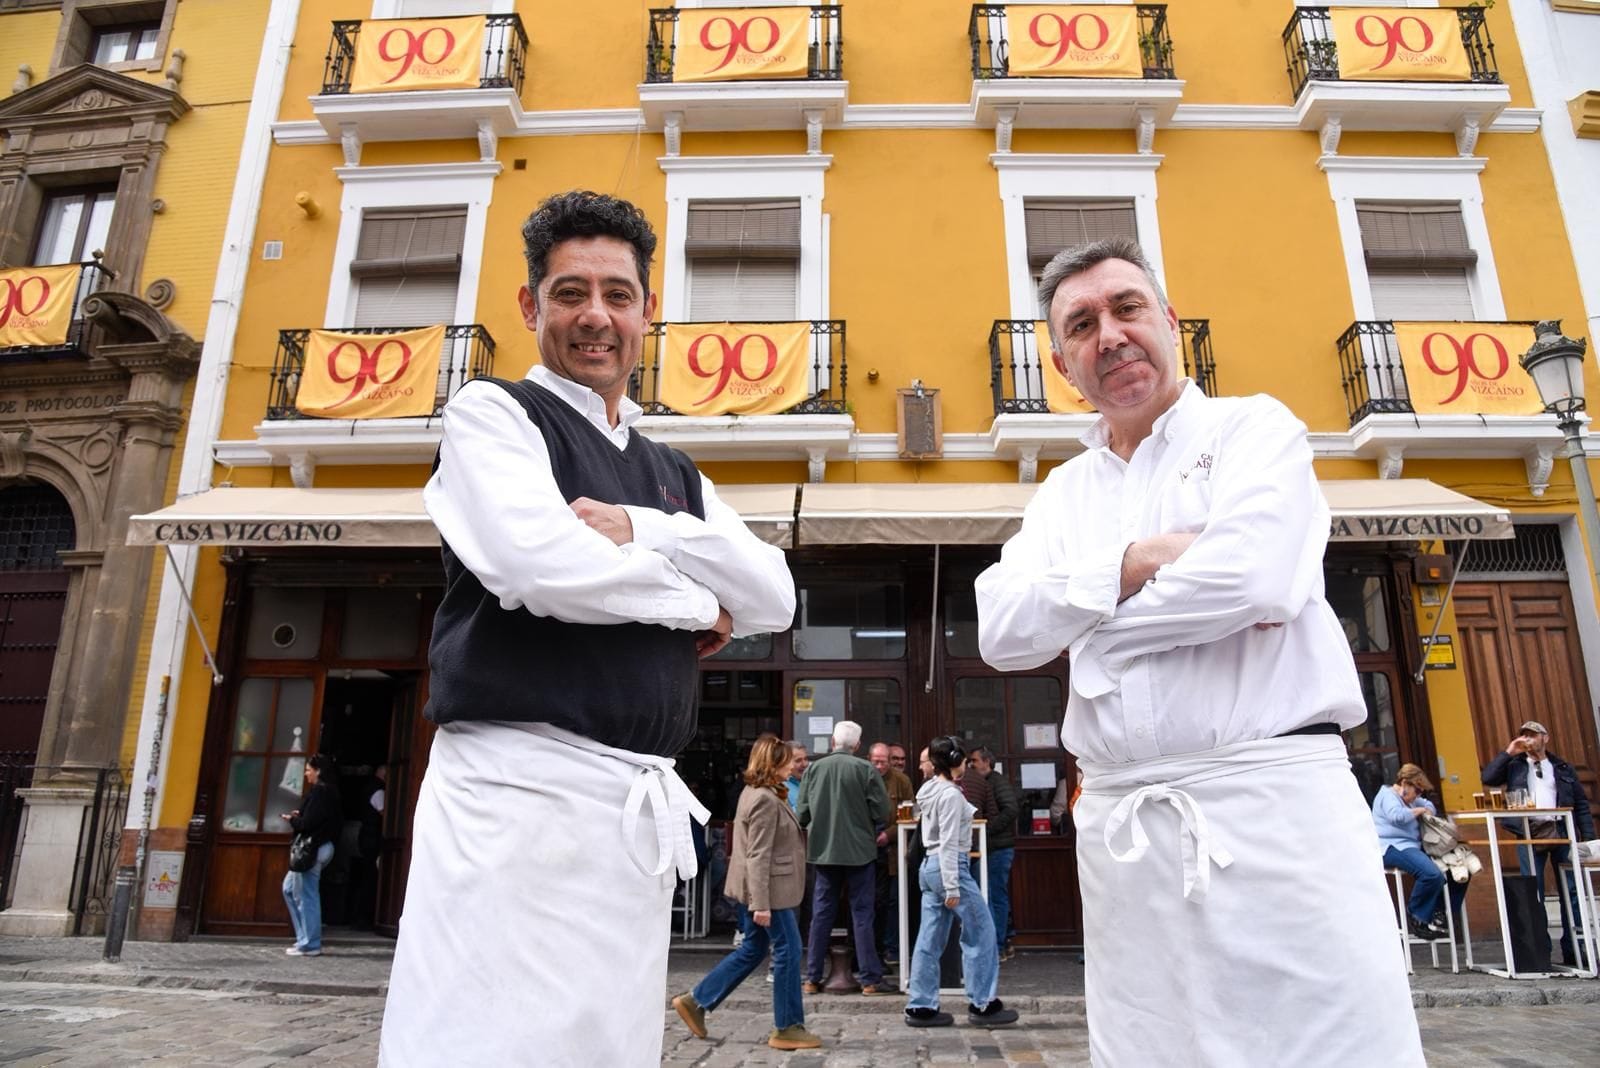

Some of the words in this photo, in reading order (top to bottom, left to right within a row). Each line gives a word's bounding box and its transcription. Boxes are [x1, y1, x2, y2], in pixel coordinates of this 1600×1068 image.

[378, 27, 455, 84] 90
[700, 16, 780, 74] 90
[1029, 13, 1109, 68] 90
[1354, 15, 1434, 71] 90
[328, 339, 412, 410] 90
[688, 333, 777, 406] 90
[1421, 332, 1509, 405] 90
[156, 523, 214, 541] CASA
